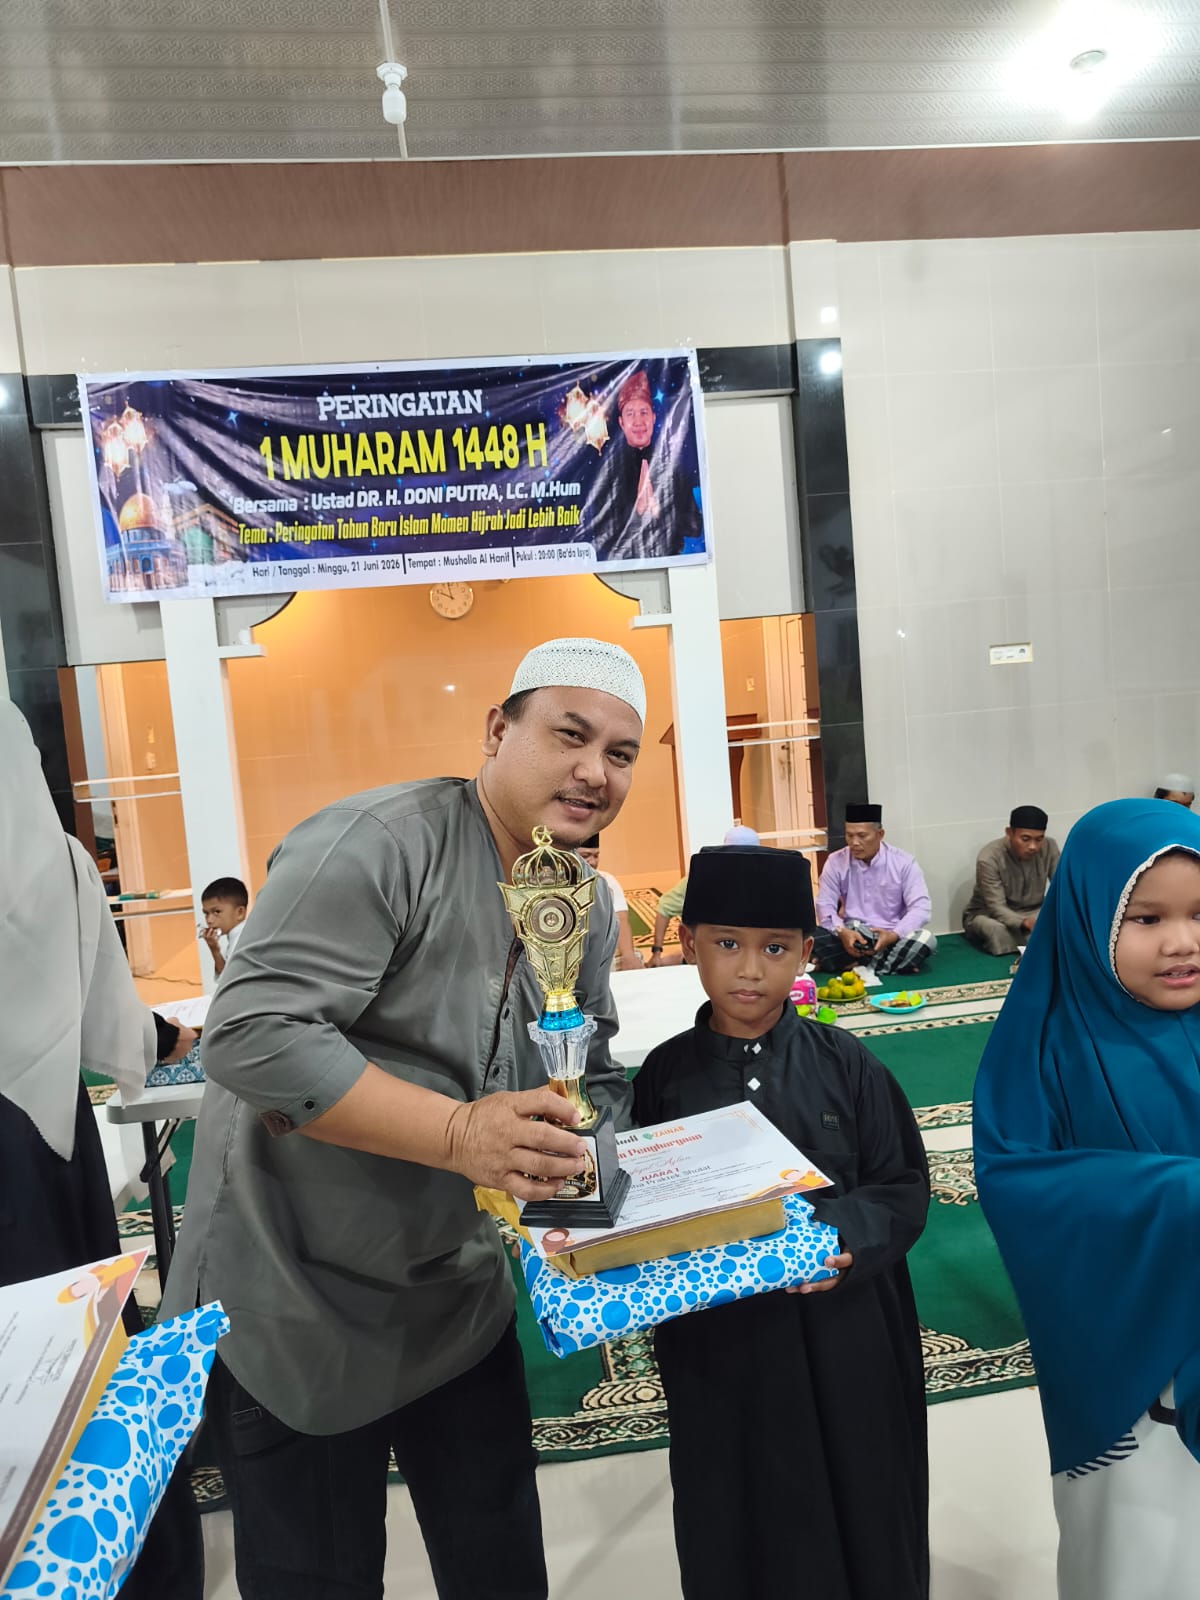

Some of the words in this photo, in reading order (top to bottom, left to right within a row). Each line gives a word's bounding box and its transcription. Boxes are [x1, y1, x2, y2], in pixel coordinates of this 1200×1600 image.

[317, 389, 482, 421] PERINGATAN
[259, 436, 274, 481] 1
[280, 428, 446, 480] MUHARAM
[452, 424, 519, 471] 1448
[525, 422, 548, 468] H
[233, 497, 297, 514] Bersama
[304, 496, 309, 511] :
[311, 491, 354, 510] Ustad
[357, 490, 382, 507] DR.
[386, 489, 401, 506] H.
[404, 486, 443, 505] DONI
[446, 483, 503, 502] PUTRA,
[506, 482, 528, 500] LC.
[531, 480, 581, 498] M.Hum
[238, 524, 267, 545] Tema
[275, 520, 335, 545] Peringatan
[337, 517, 369, 540] Tahun
[371, 516, 397, 537] Baru
[399, 514, 429, 536] Islam
[431, 512, 469, 535] Momen
[471, 509, 503, 535] Hijrah
[505, 508, 526, 530] Jadi
[528, 506, 555, 528] Lebih
[557, 504, 580, 526] Baik
[408, 557, 436, 570] Tempat
[443, 555, 477, 566] Musholla
[479, 553, 488, 564] Al
[490, 551, 510, 563] Hanif
[516, 550, 533, 562] Pukul
[538, 549, 556, 560] 20:00
[252, 566, 270, 577] Hari
[278, 565, 311, 578] Tanggal
[317, 563, 350, 575] Minggu,
[351, 561, 361, 572] 21
[363, 560, 379, 571] Juni
[381, 559, 401, 570] 2026
[640, 1168, 673, 1182] JUARA
